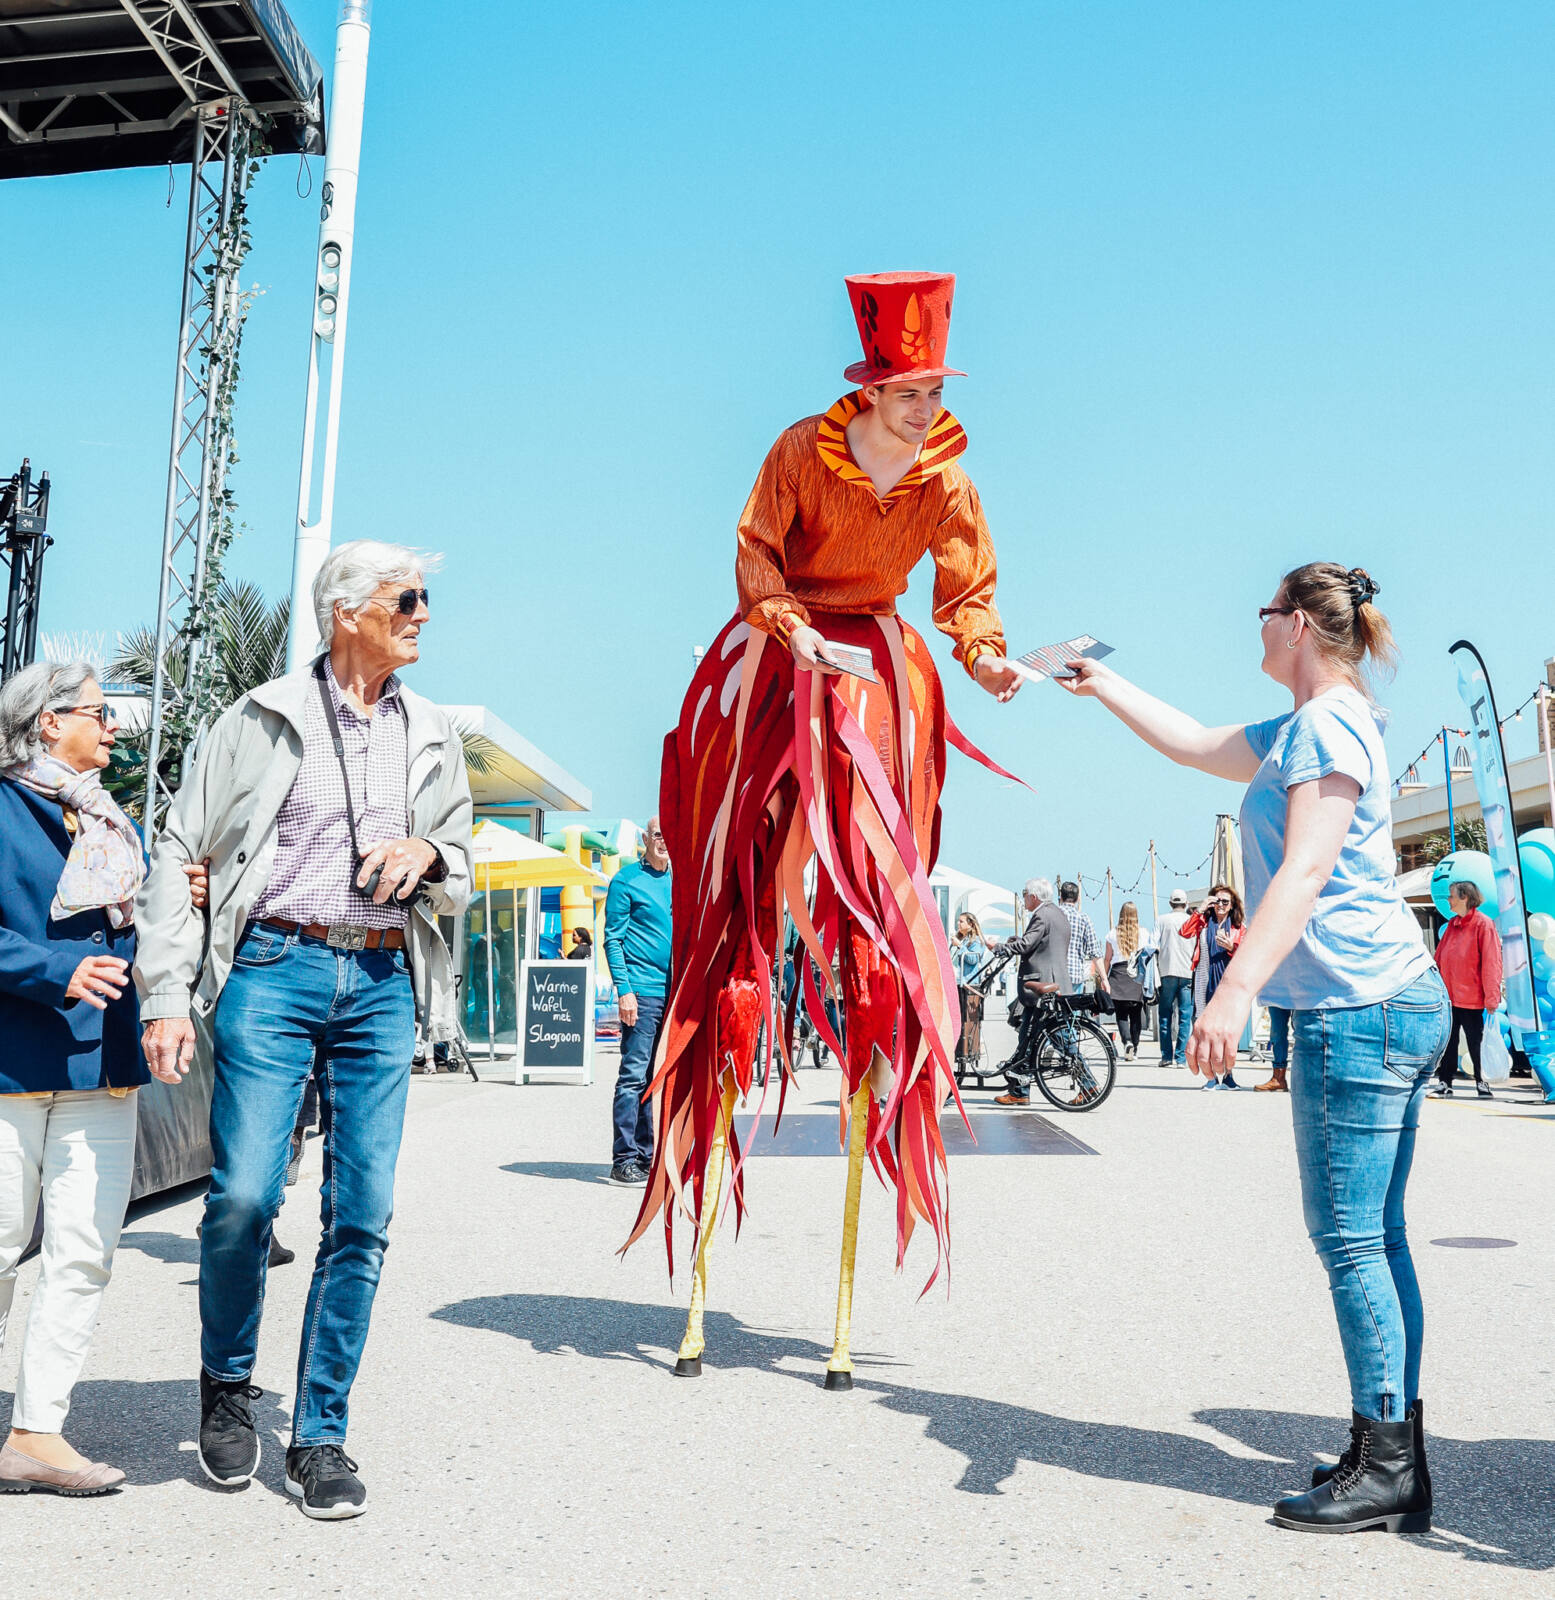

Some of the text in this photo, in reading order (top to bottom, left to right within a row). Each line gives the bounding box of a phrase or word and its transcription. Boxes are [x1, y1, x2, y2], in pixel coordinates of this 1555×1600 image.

[533, 973, 579, 995] Warme
[532, 995, 568, 1012] Wafel
[552, 1012, 571, 1023] met
[529, 1024, 581, 1049] Slagroom
